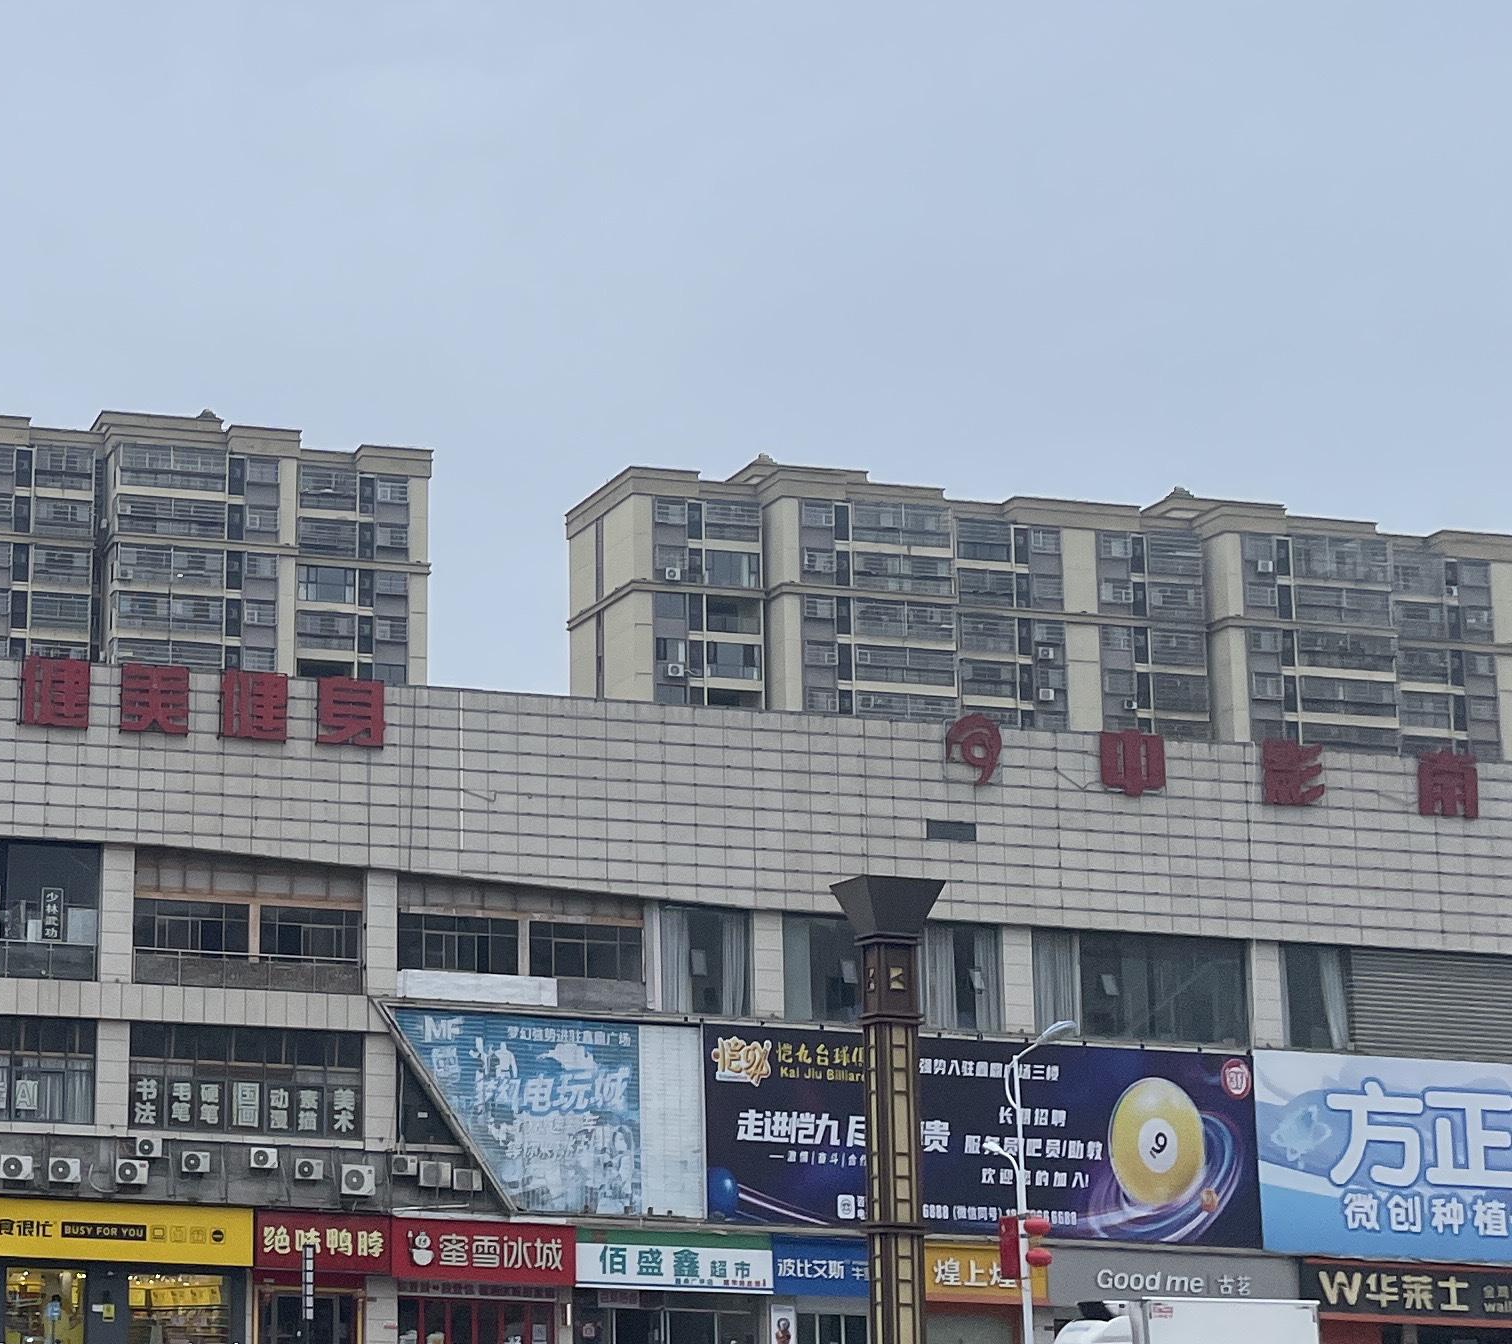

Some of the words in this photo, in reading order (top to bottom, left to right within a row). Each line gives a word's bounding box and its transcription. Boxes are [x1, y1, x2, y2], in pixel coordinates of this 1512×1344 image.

[423, 1015, 465, 1044] MF
[134, 1077, 158, 1125] 书法
[171, 1082, 192, 1123] 毛笔
[333, 1086, 356, 1133] 美术
[1325, 1080, 1512, 1188] 方正
[64, 1224, 92, 1237] BUSY
[96, 1225, 117, 1238] FOR
[121, 1227, 144, 1239] YOU
[263, 1225, 384, 1259] 绝味鸭脖
[438, 1233, 564, 1272] 蜜雪冰城
[599, 1245, 701, 1279] 佰盛鑫
[709, 1259, 752, 1280] 超市
[1096, 1268, 1161, 1294] Good
[1165, 1273, 1204, 1297] me
[1217, 1274, 1252, 1297] 古茗
[1365, 1272, 1470, 1313] 华莱士
